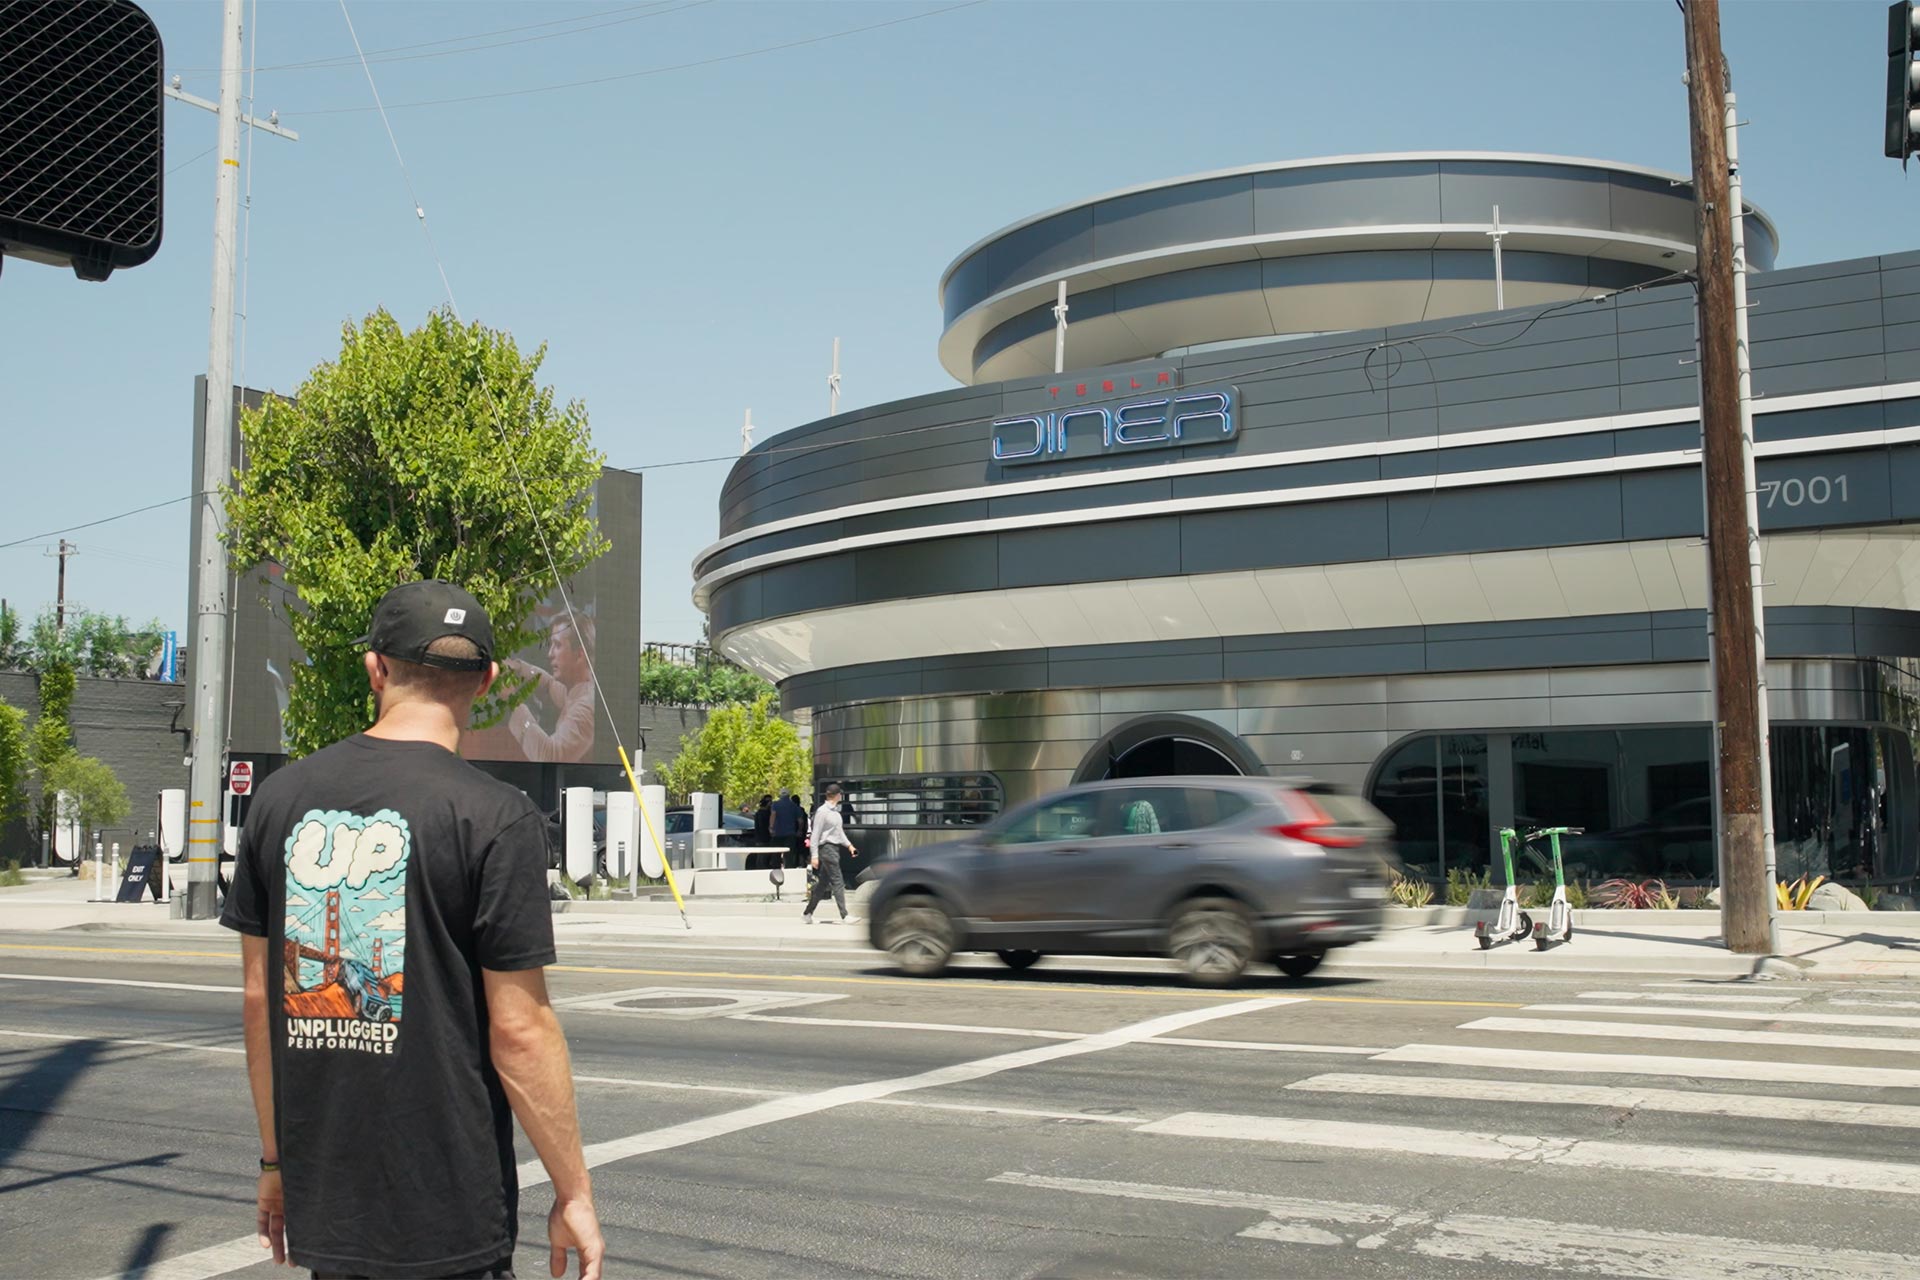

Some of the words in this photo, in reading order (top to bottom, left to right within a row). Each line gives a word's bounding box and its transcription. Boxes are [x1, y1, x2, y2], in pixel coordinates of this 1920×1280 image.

[1049, 372, 1169, 398] TESLA
[992, 392, 1231, 460] DINER
[1760, 474, 1848, 509] 7001
[288, 819, 406, 892] UP
[127, 874, 143, 882] ONLY
[132, 865, 145, 873] EXIT
[287, 1017, 399, 1042] UNPLUGGED
[287, 1036, 394, 1054] PERFORMANCE
